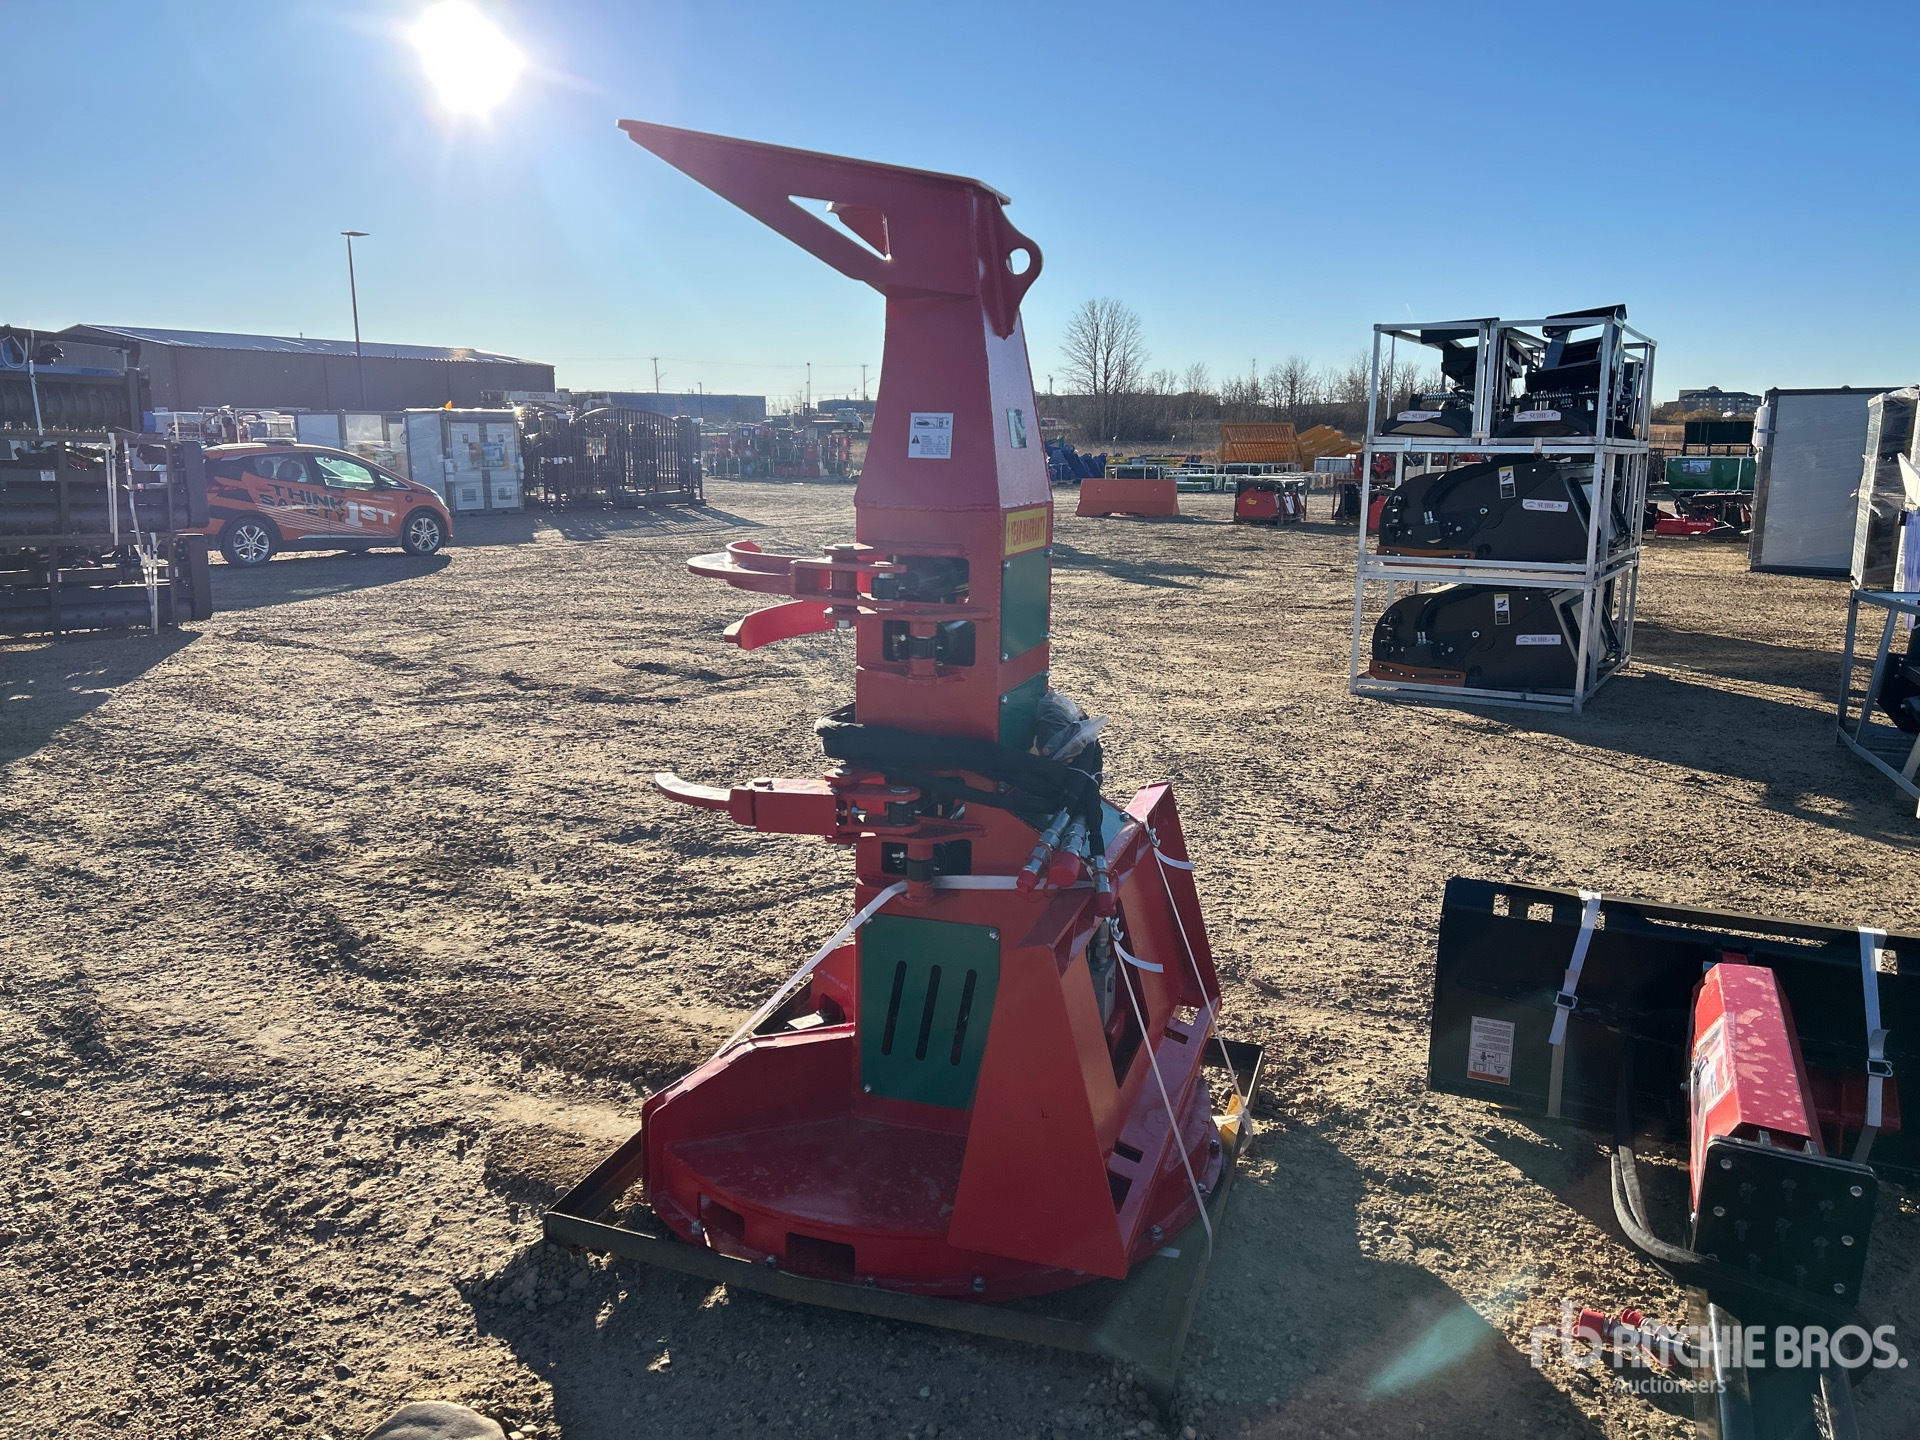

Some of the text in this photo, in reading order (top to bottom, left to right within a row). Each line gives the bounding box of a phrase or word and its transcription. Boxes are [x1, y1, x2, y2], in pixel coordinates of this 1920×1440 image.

[259, 493, 345, 521] SAFETY
[267, 483, 344, 510] THINK
[345, 501, 396, 527] 1ST
[1010, 519, 1023, 546] YEAR
[1023, 515, 1046, 544] WARRANTY
